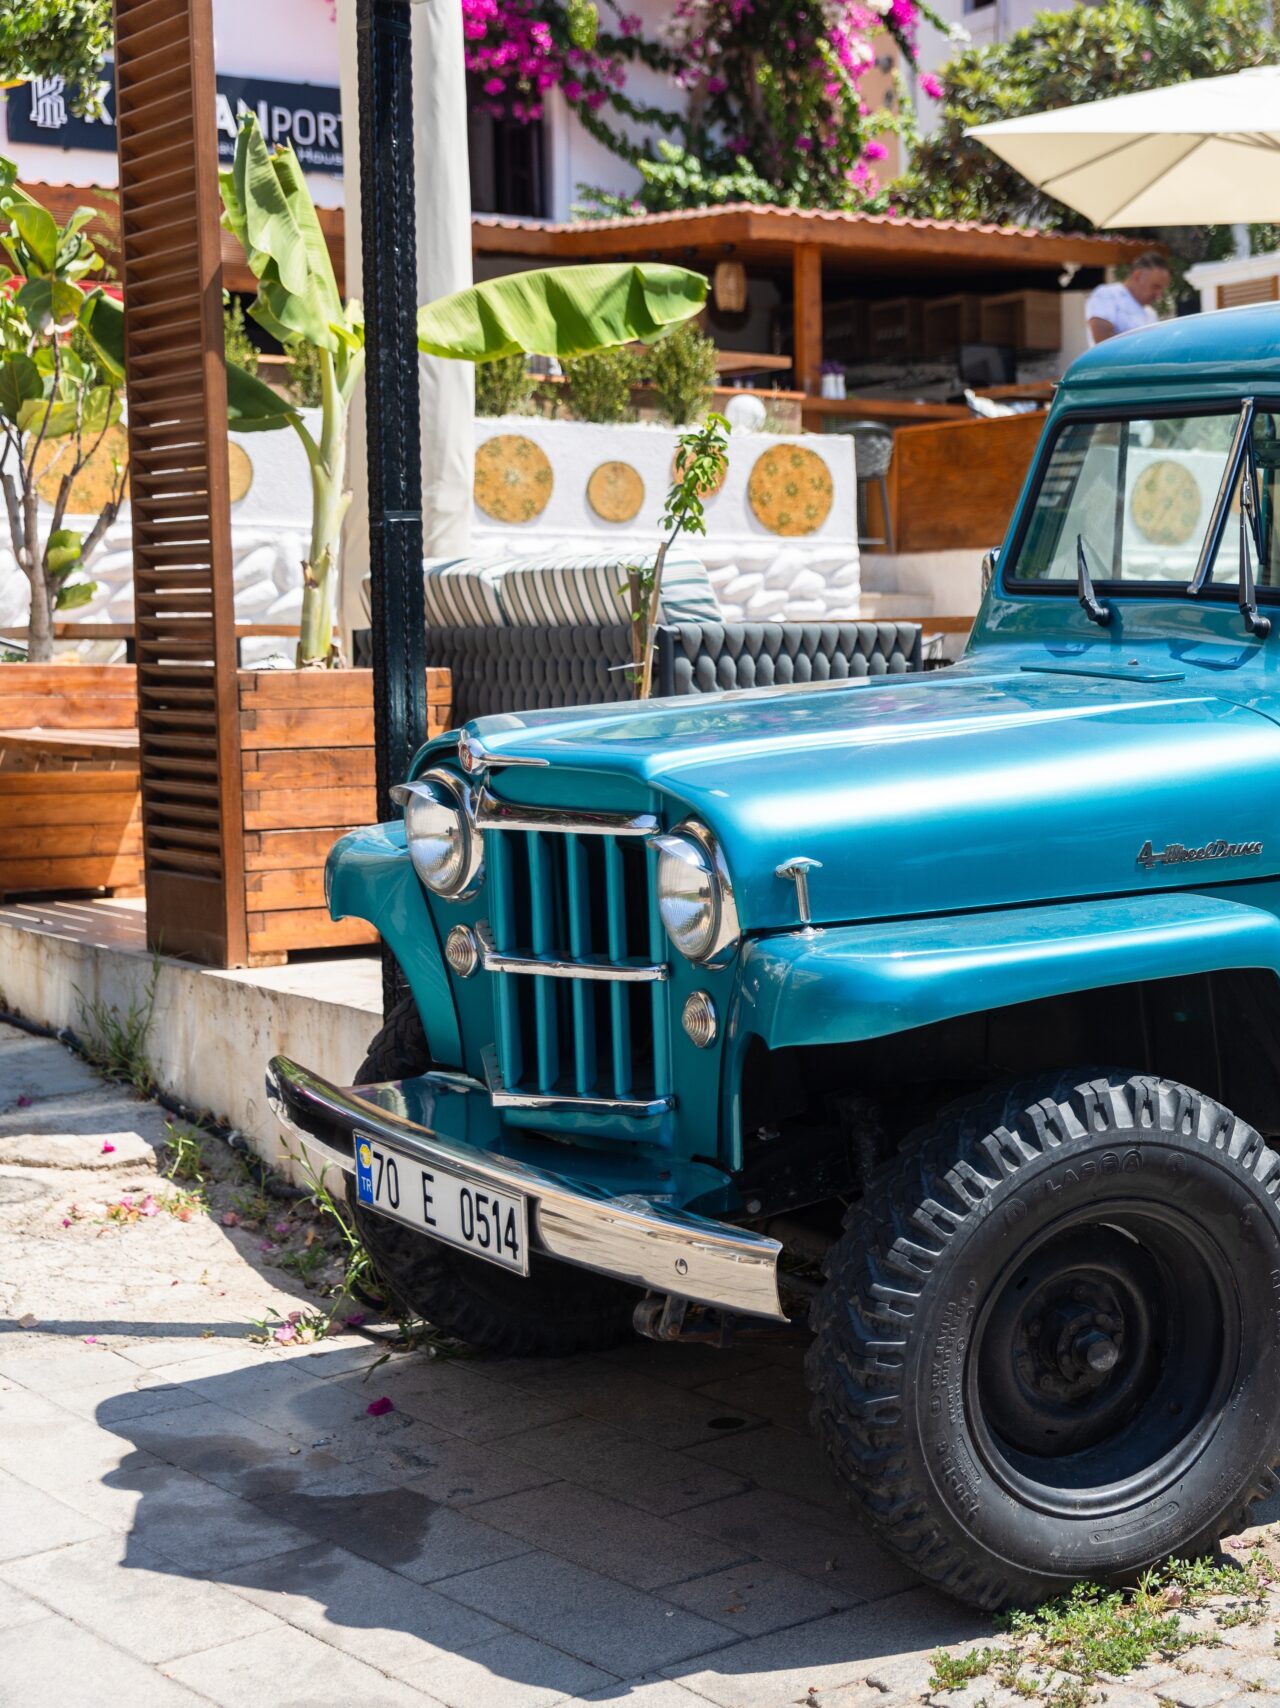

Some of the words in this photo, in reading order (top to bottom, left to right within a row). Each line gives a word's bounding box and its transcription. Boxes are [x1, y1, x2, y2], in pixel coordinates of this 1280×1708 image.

[361, 1176, 373, 1193] TR
[373, 1150, 400, 1210] 70
[421, 1171, 437, 1227] E
[460, 1187, 519, 1260] 0514
